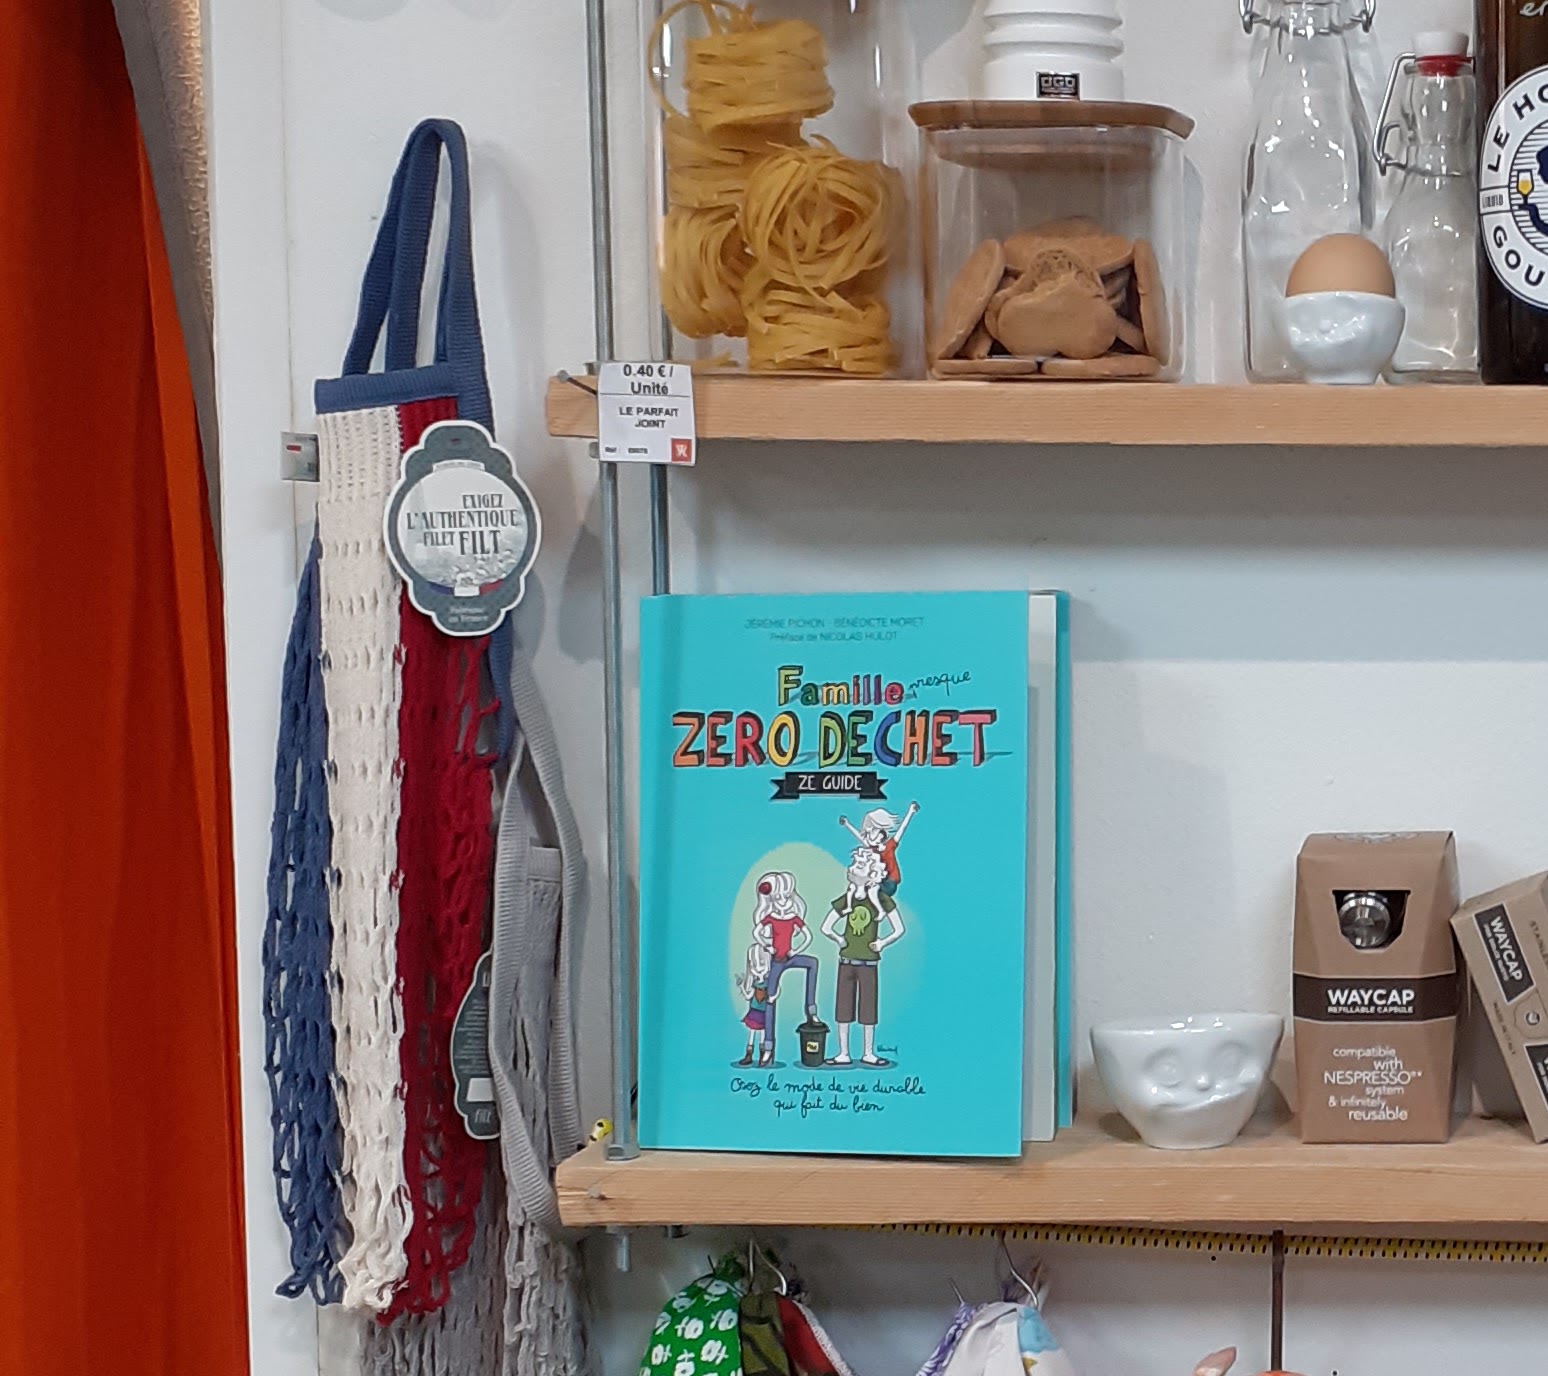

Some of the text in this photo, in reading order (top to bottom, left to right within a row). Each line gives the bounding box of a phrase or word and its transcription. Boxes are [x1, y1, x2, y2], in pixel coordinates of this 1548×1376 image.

[1487, 125, 1511, 173] LE
[623, 364, 654, 378] 0.40
[657, 365, 666, 378] €
[630, 381, 669, 396] Unité
[619, 407, 680, 417] LE PARFAIT
[634, 419, 666, 428] JOINT
[462, 493, 504, 509] EXIGEZ
[423, 529, 501, 556] FILET FILT
[788, 618, 825, 628] PICHON
[889, 616, 924, 627] MORET
[820, 632, 863, 641] NICOLAS
[865, 631, 897, 641] HULOT
[777, 665, 905, 707] Famille
[672, 708, 998, 769] ZERO DECHET
[797, 774, 863, 791] ZE GUIDE
[1490, 916, 1523, 982] WAYCAP
[1328, 989, 1415, 1005] WAYCAP
[1328, 1006, 1413, 1014] REFILLABLE CAPSULE
[1333, 1046, 1396, 1059] compatible
[1373, 1057, 1403, 1071] with
[767, 1073, 780, 1092] le
[784, 1076, 824, 1093] mode
[828, 1076, 845, 1093] de
[872, 1076, 927, 1096] durable
[1365, 1085, 1405, 1097] system
[774, 1095, 885, 1118] qui fait du bien
[1328, 1096, 1386, 1110] & infinitely
[1348, 1106, 1408, 1121] reusable
